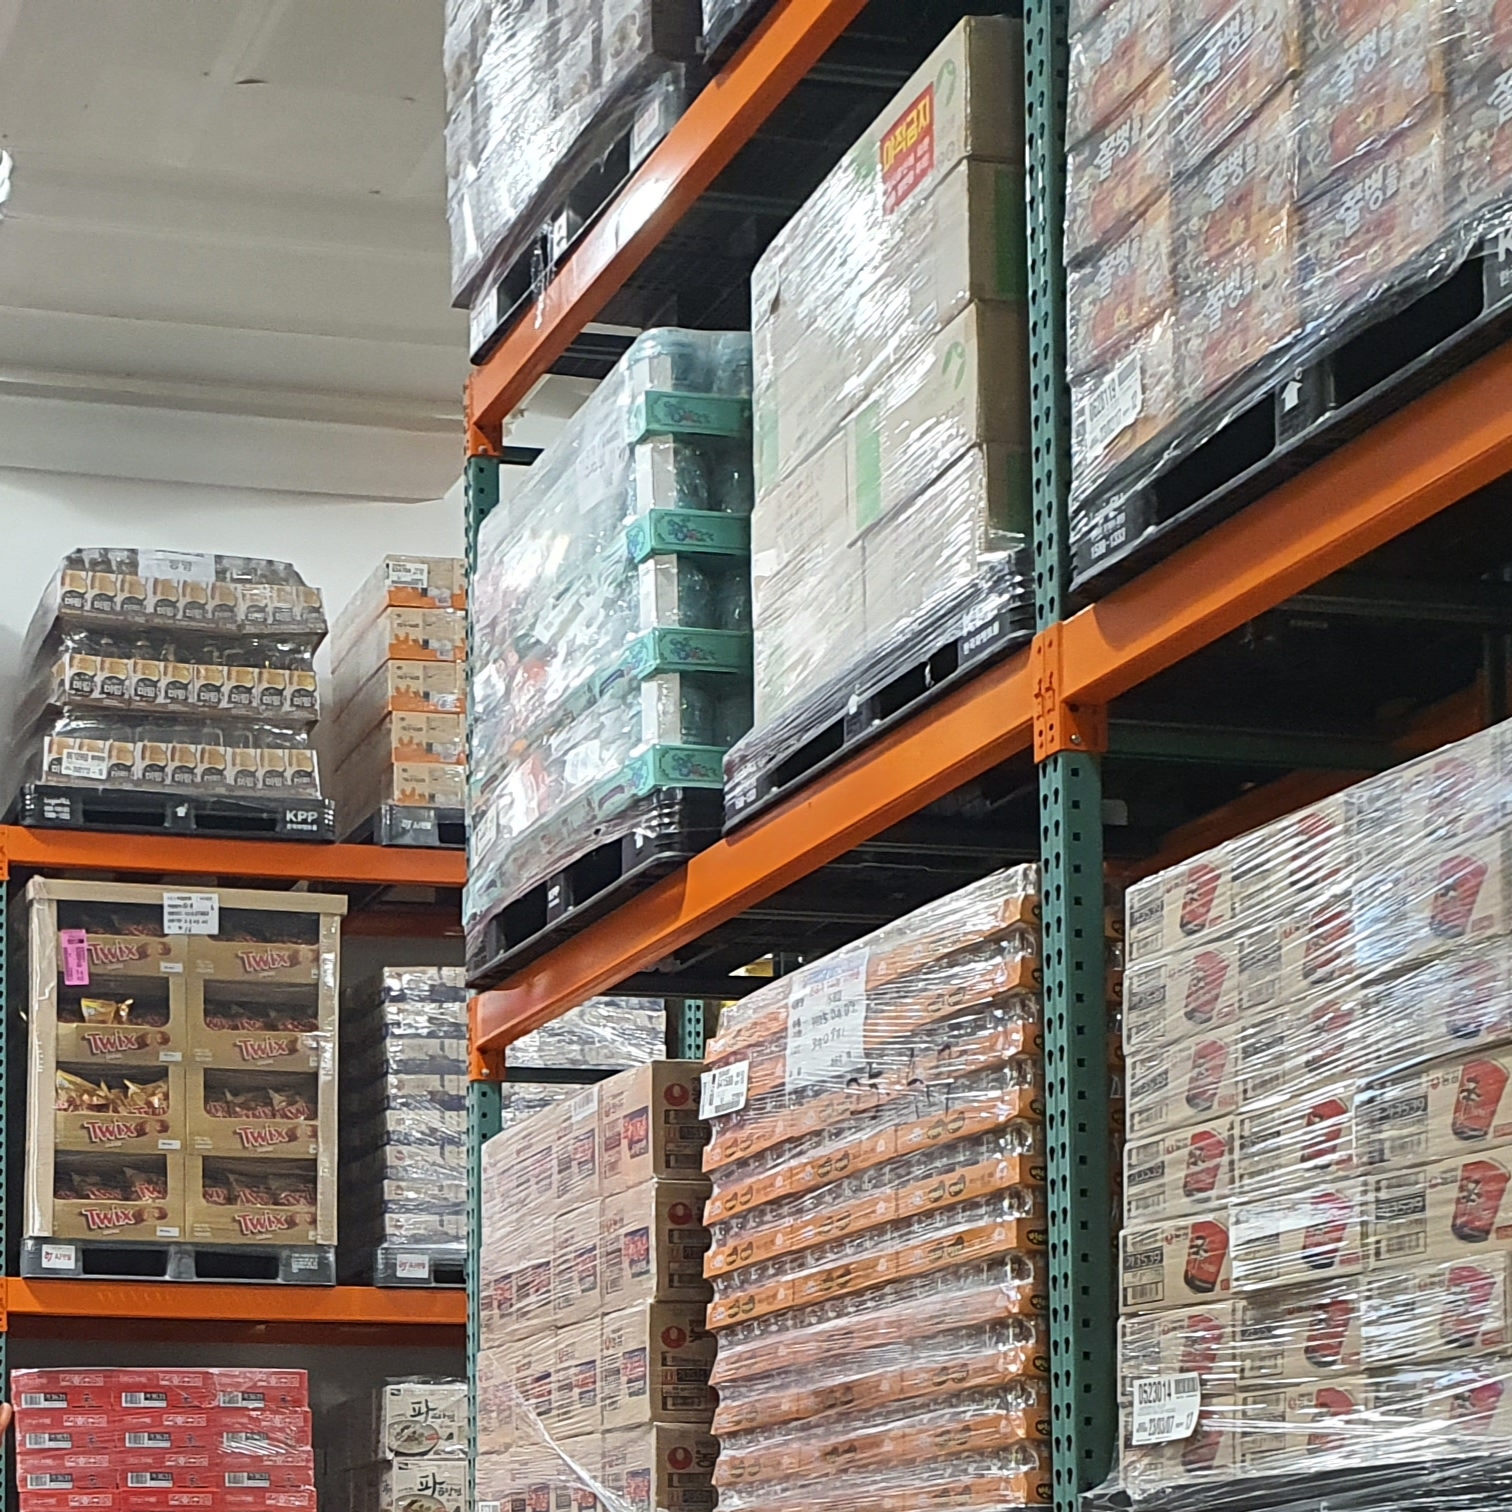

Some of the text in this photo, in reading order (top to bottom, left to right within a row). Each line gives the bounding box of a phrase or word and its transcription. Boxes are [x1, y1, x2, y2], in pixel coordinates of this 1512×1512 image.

[286, 811, 317, 822] KPP
[87, 942, 139, 963] Twix
[239, 950, 289, 973] Twix
[86, 1031, 138, 1054] Twix
[238, 1038, 289, 1061] Twix
[85, 1120, 136, 1141] Twix
[237, 1125, 289, 1149] Twix
[83, 1207, 135, 1228] Twix
[236, 1212, 288, 1235] Twix
[410, 1399, 437, 1423] 파
[417, 1473, 445, 1496] 파
